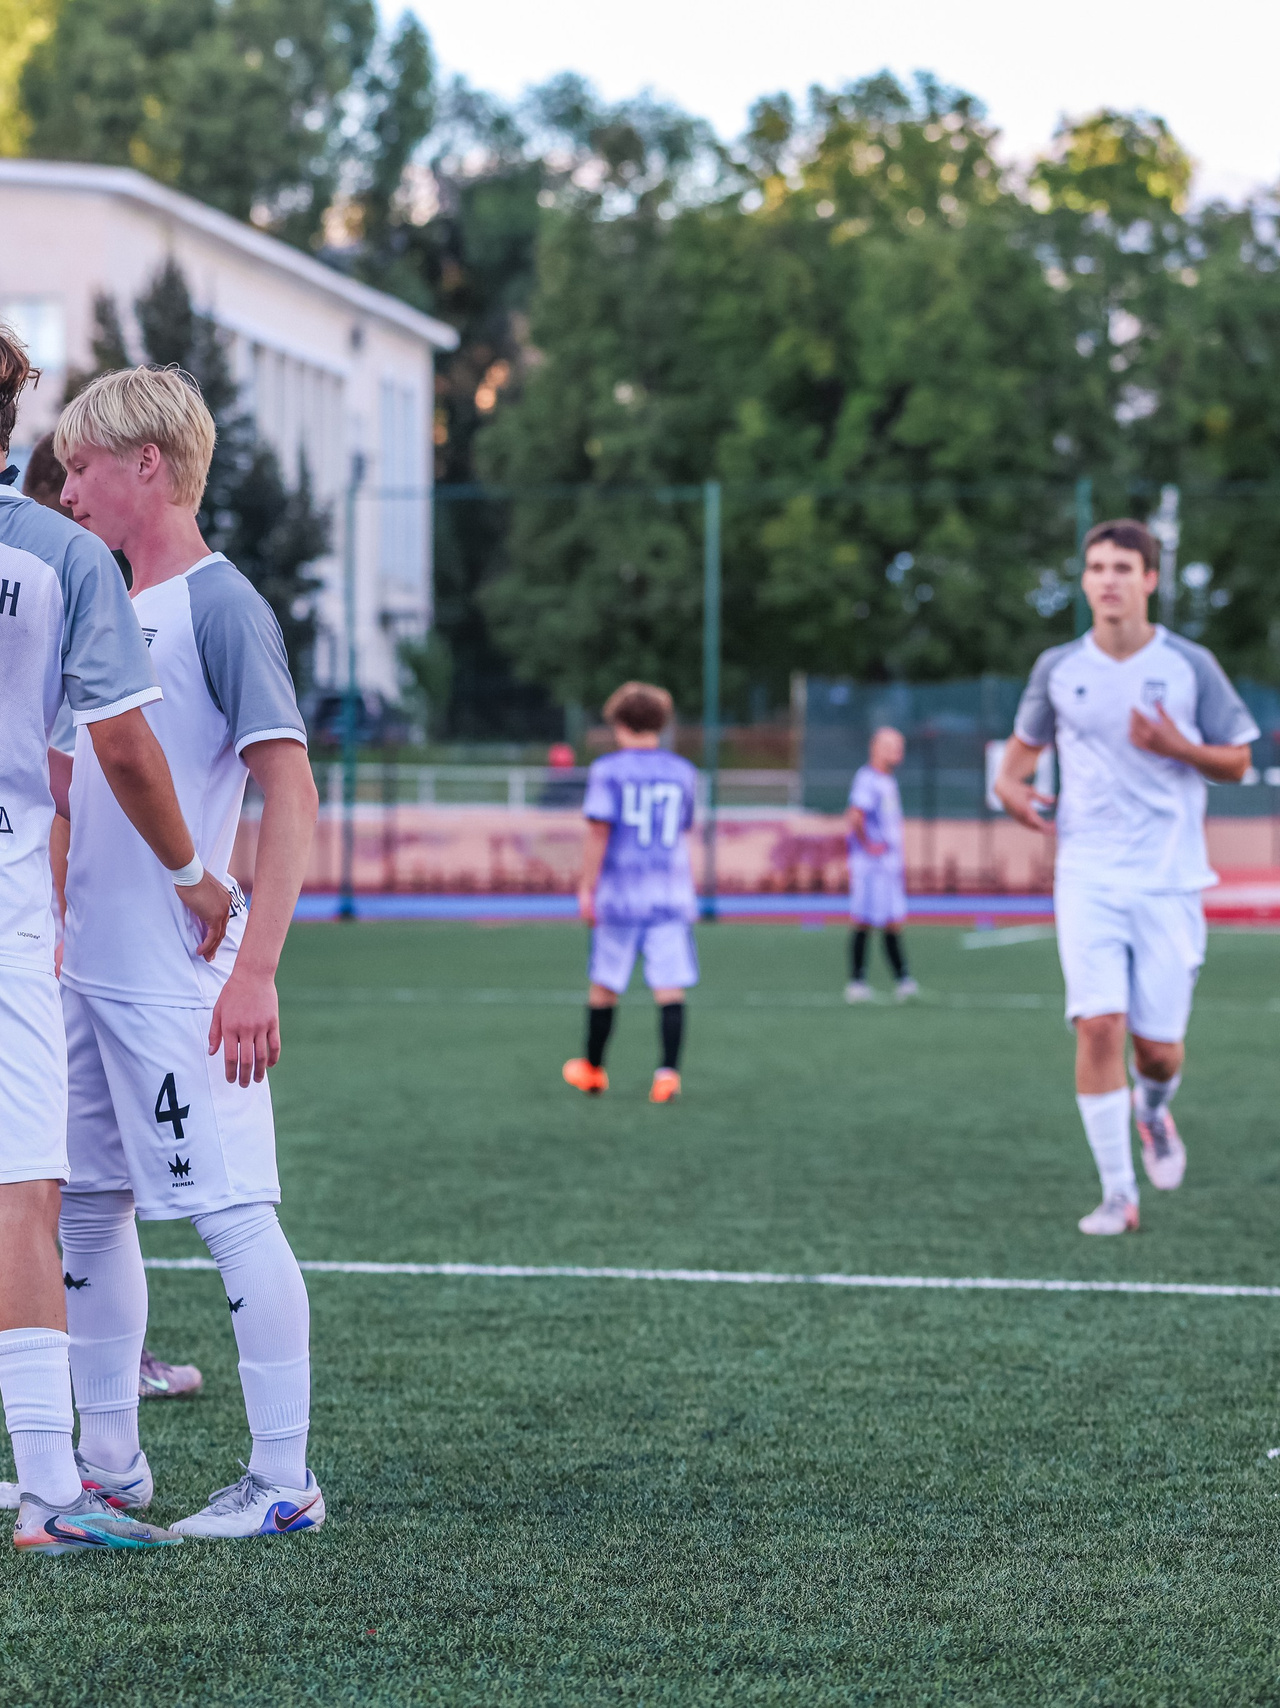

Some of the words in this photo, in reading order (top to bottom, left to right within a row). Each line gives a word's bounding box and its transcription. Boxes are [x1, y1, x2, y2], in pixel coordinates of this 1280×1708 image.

[622, 782, 681, 848] 47
[154, 1072, 190, 1140] 4
[171, 1180, 195, 1188] PRIMERA
